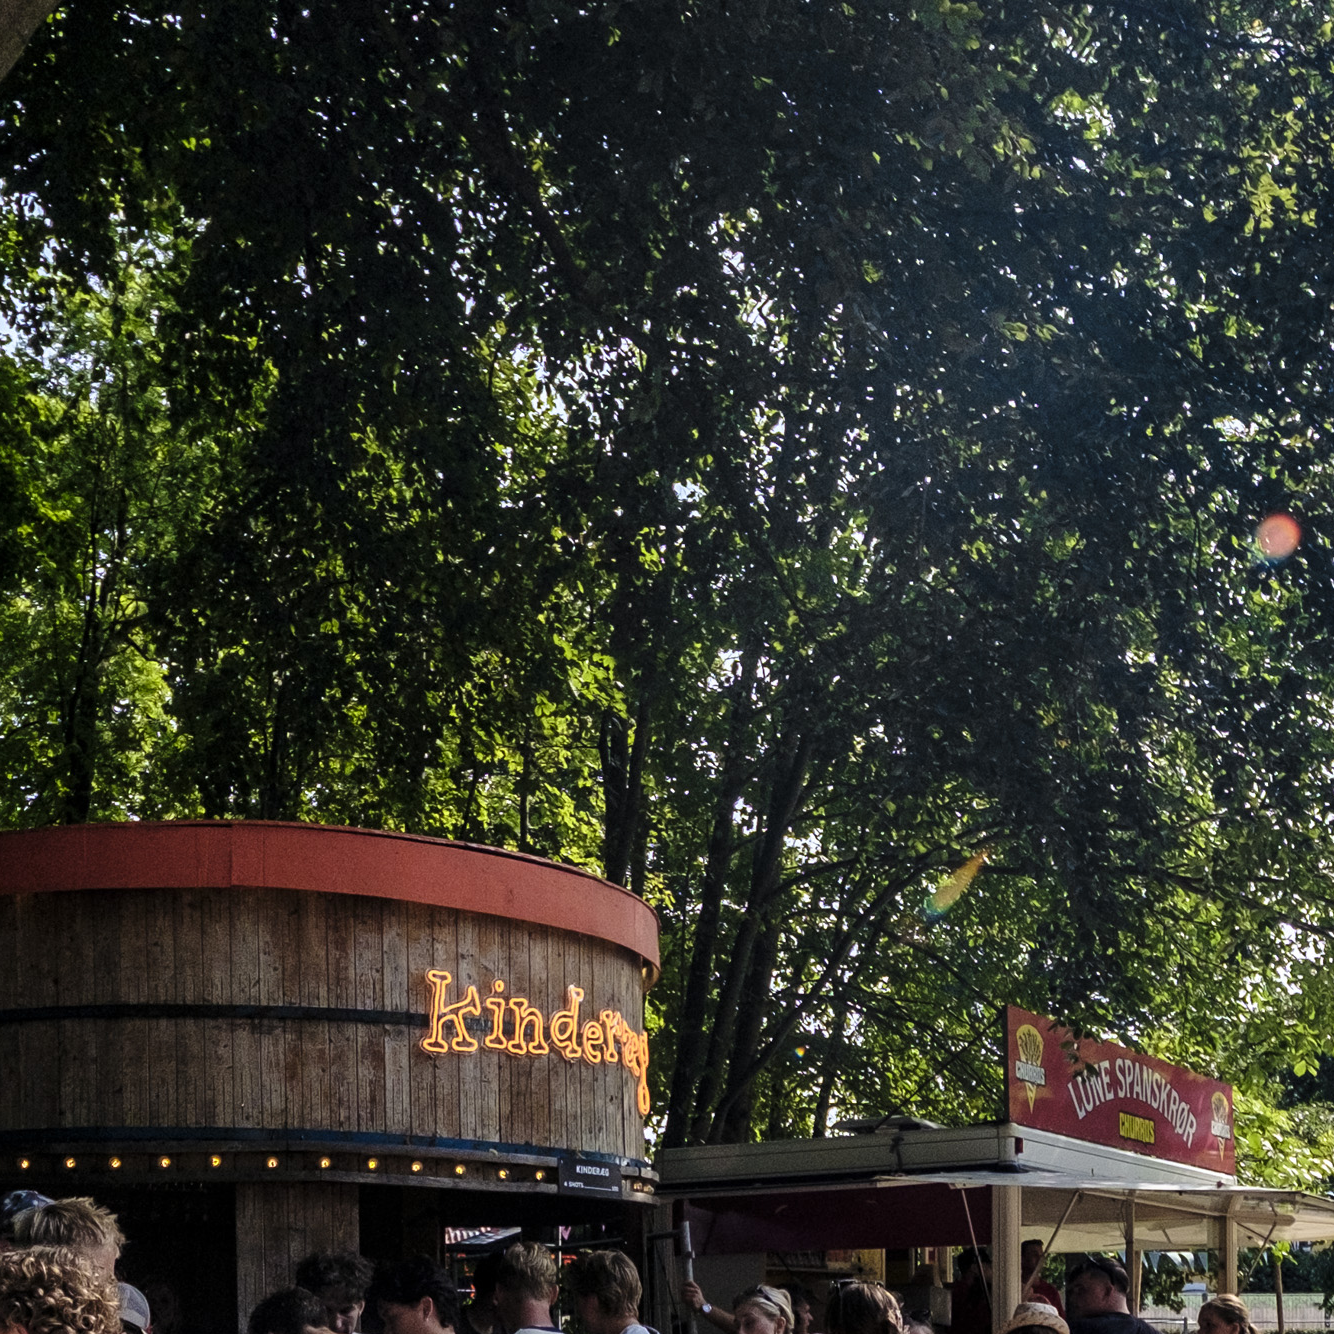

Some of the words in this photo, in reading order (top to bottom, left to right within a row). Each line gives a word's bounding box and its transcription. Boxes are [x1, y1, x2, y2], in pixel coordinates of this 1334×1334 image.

[1067, 1059, 1115, 1120] LUNE
[1115, 1057, 1197, 1149] SPANSKRØR
[1118, 1111, 1155, 1144] CHURROS
